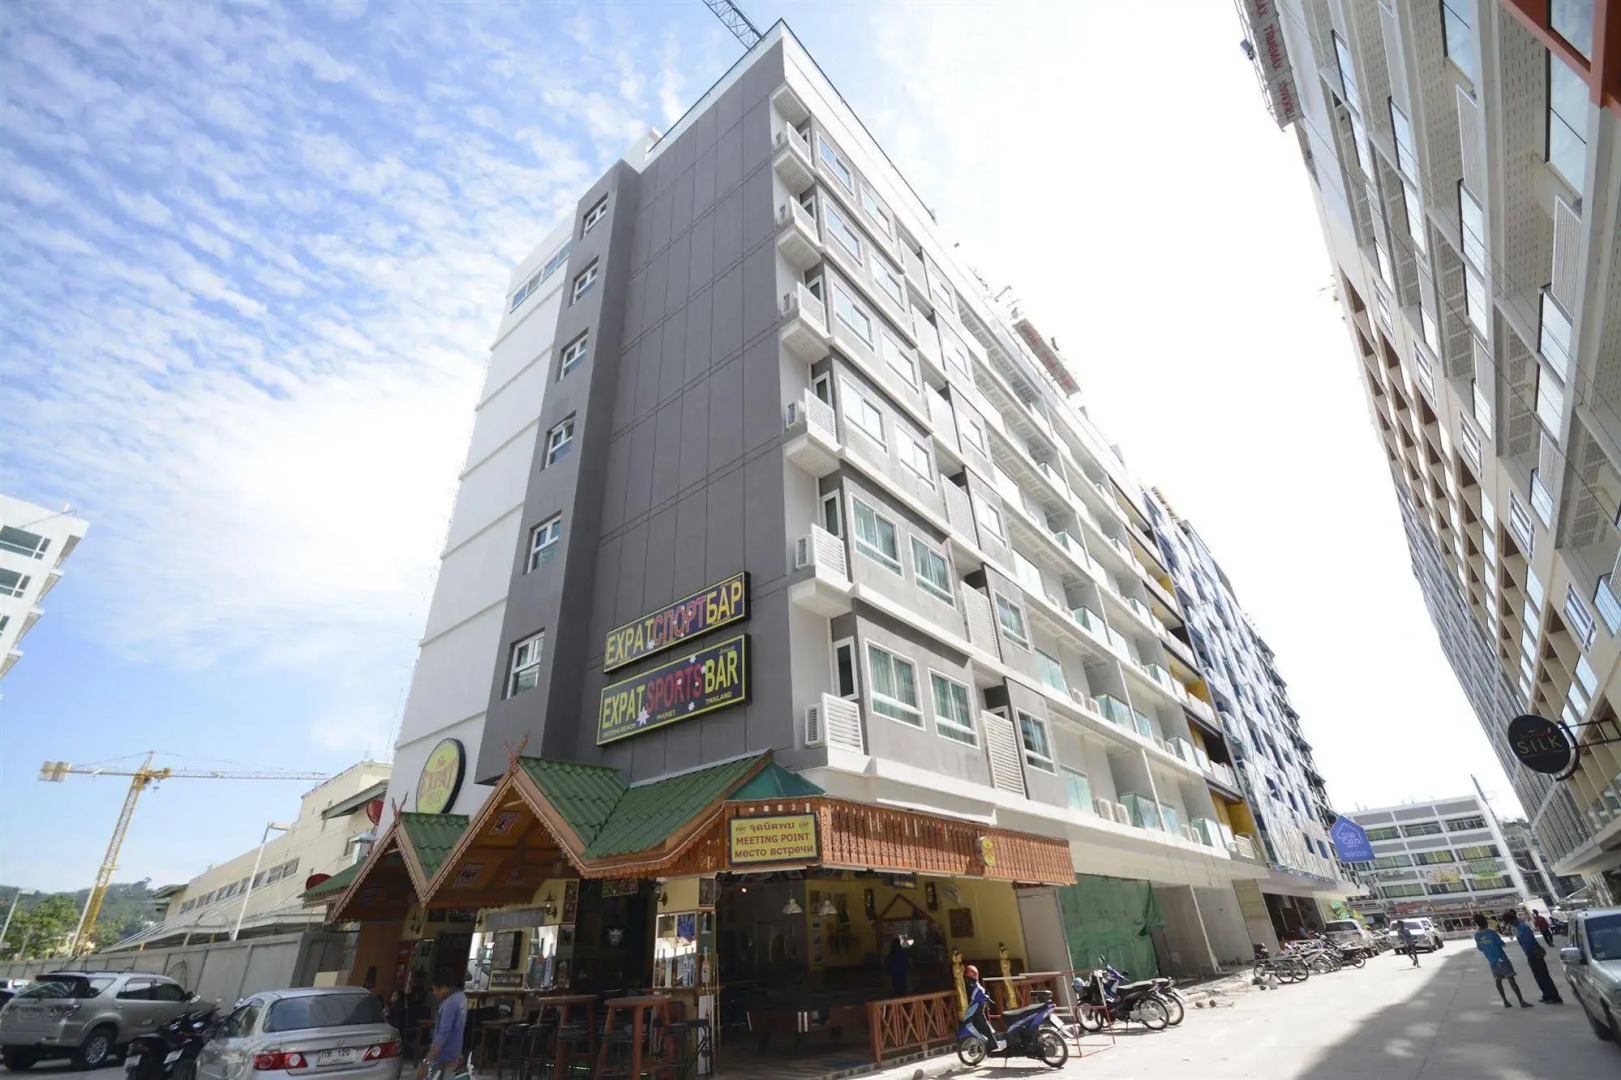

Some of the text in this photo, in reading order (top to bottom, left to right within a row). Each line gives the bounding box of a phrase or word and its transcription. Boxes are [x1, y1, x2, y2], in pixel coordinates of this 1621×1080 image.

[605, 617, 655, 666] EXPAT
[705, 580, 743, 625] БАР
[602, 649, 739, 729] EXPAT SPORTS BAR
[1517, 735, 1563, 755] SILK
[736, 832, 810, 846] MEETING POINT
[770, 845, 814, 857] встречи
